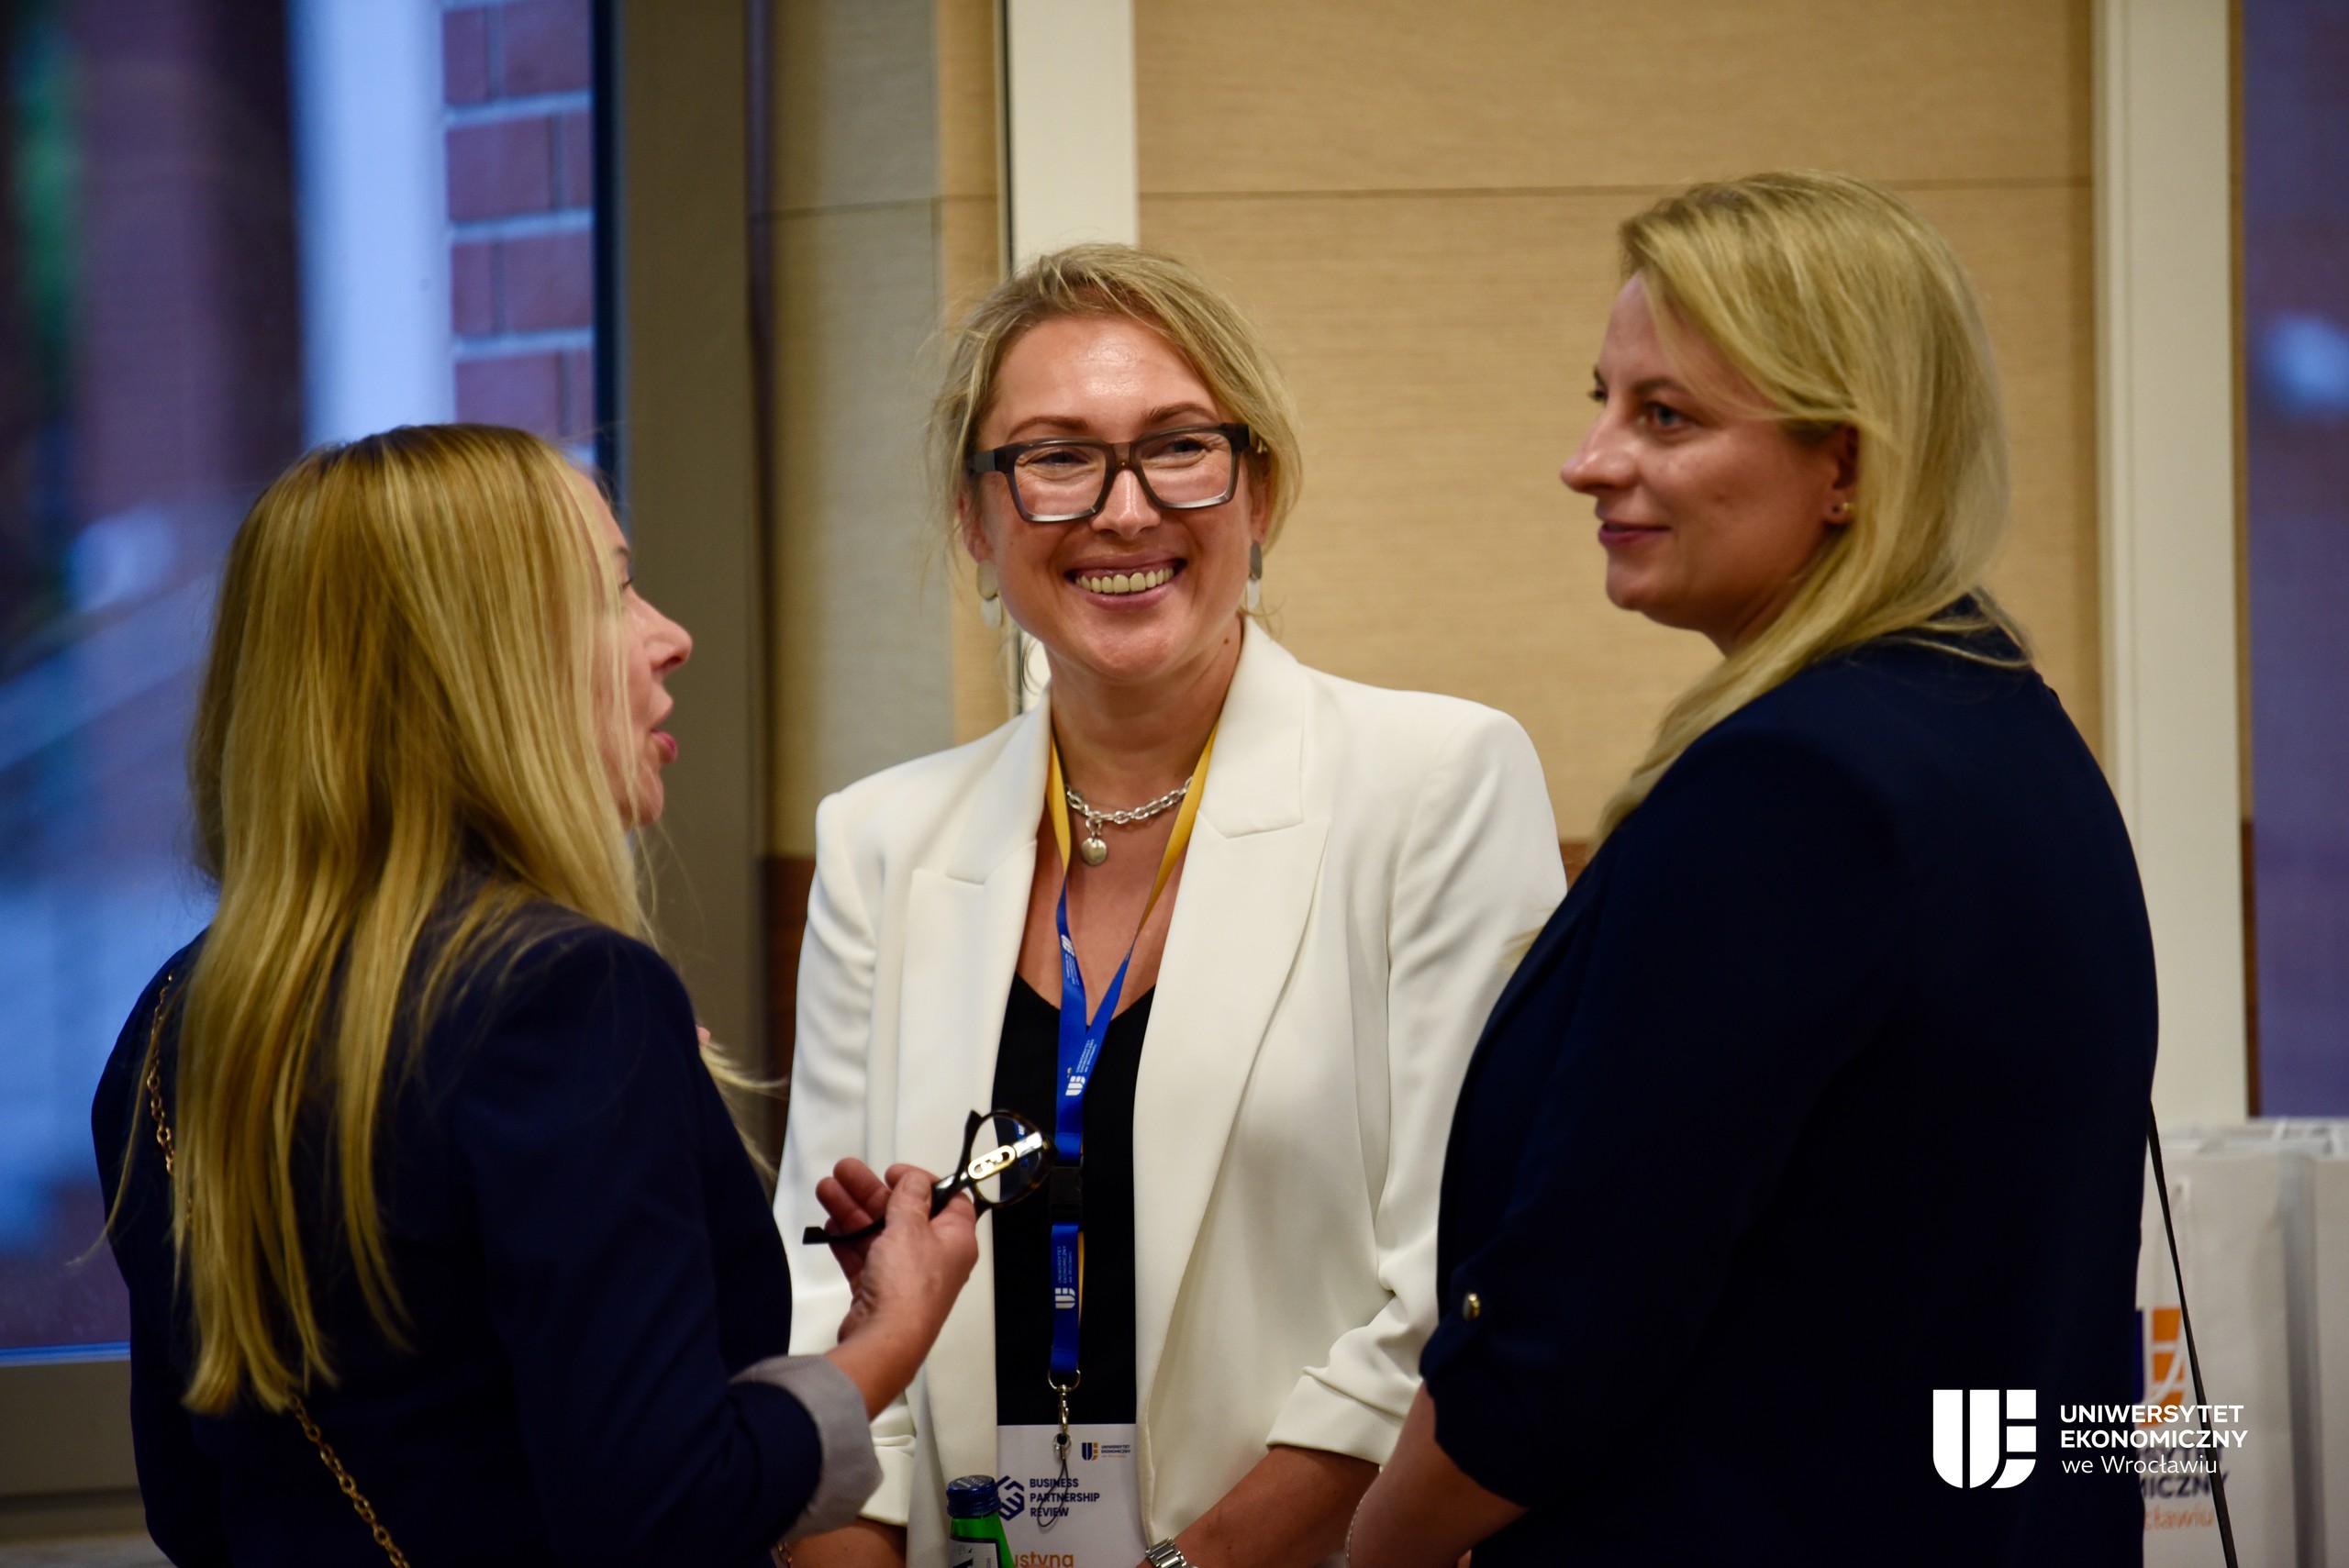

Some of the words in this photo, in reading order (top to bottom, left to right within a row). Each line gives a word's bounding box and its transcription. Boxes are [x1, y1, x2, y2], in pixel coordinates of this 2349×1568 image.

[1030, 1478, 1079, 1488] BUSINESS
[1030, 1493, 1100, 1503] PARTNERSHIP
[1030, 1507, 1069, 1518] REVIEW
